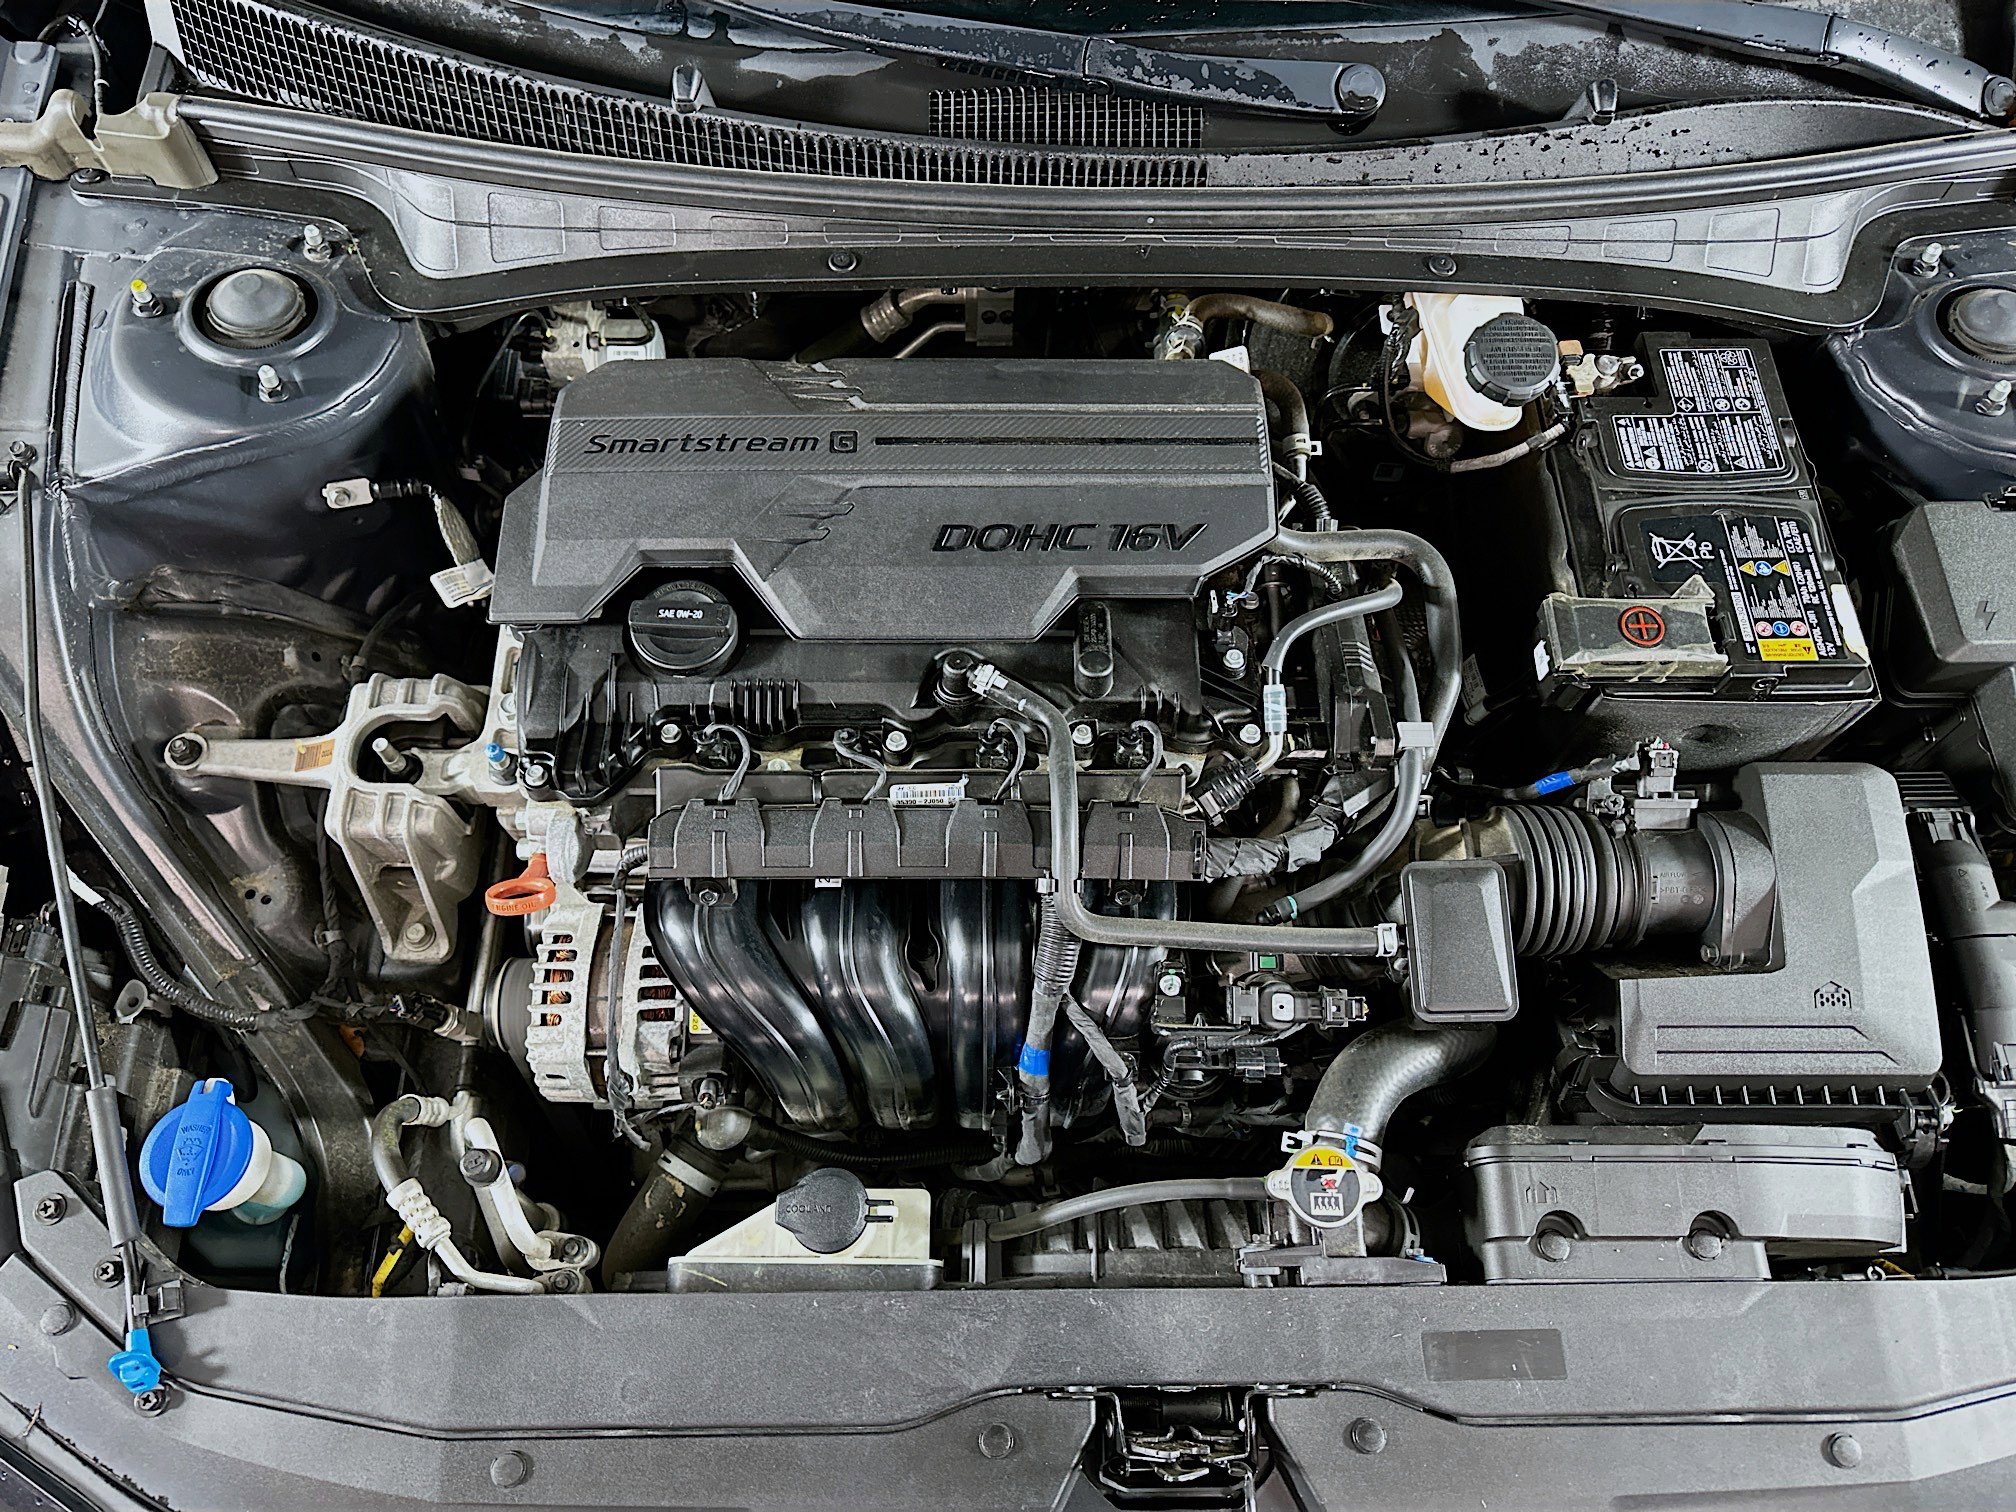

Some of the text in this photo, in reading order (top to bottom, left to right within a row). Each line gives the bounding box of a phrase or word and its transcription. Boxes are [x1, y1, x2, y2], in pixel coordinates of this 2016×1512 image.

[584, 433, 820, 454] Smartstream
[931, 523, 1208, 552] DOHC 16V
[1699, 541, 1715, 559] Pb
[1785, 538, 1796, 554] CCA
[1810, 593, 1820, 605] RC
[658, 609, 703, 618] SAE 0W-20
[1733, 594, 1752, 639] 37110-3Q700
[1825, 641, 1837, 659] 12V
[522, 902, 536, 910] OIL
[181, 1124, 212, 1134] WASHER
[177, 1168, 194, 1176] ONLY
[785, 1204, 832, 1214] COOLANT
